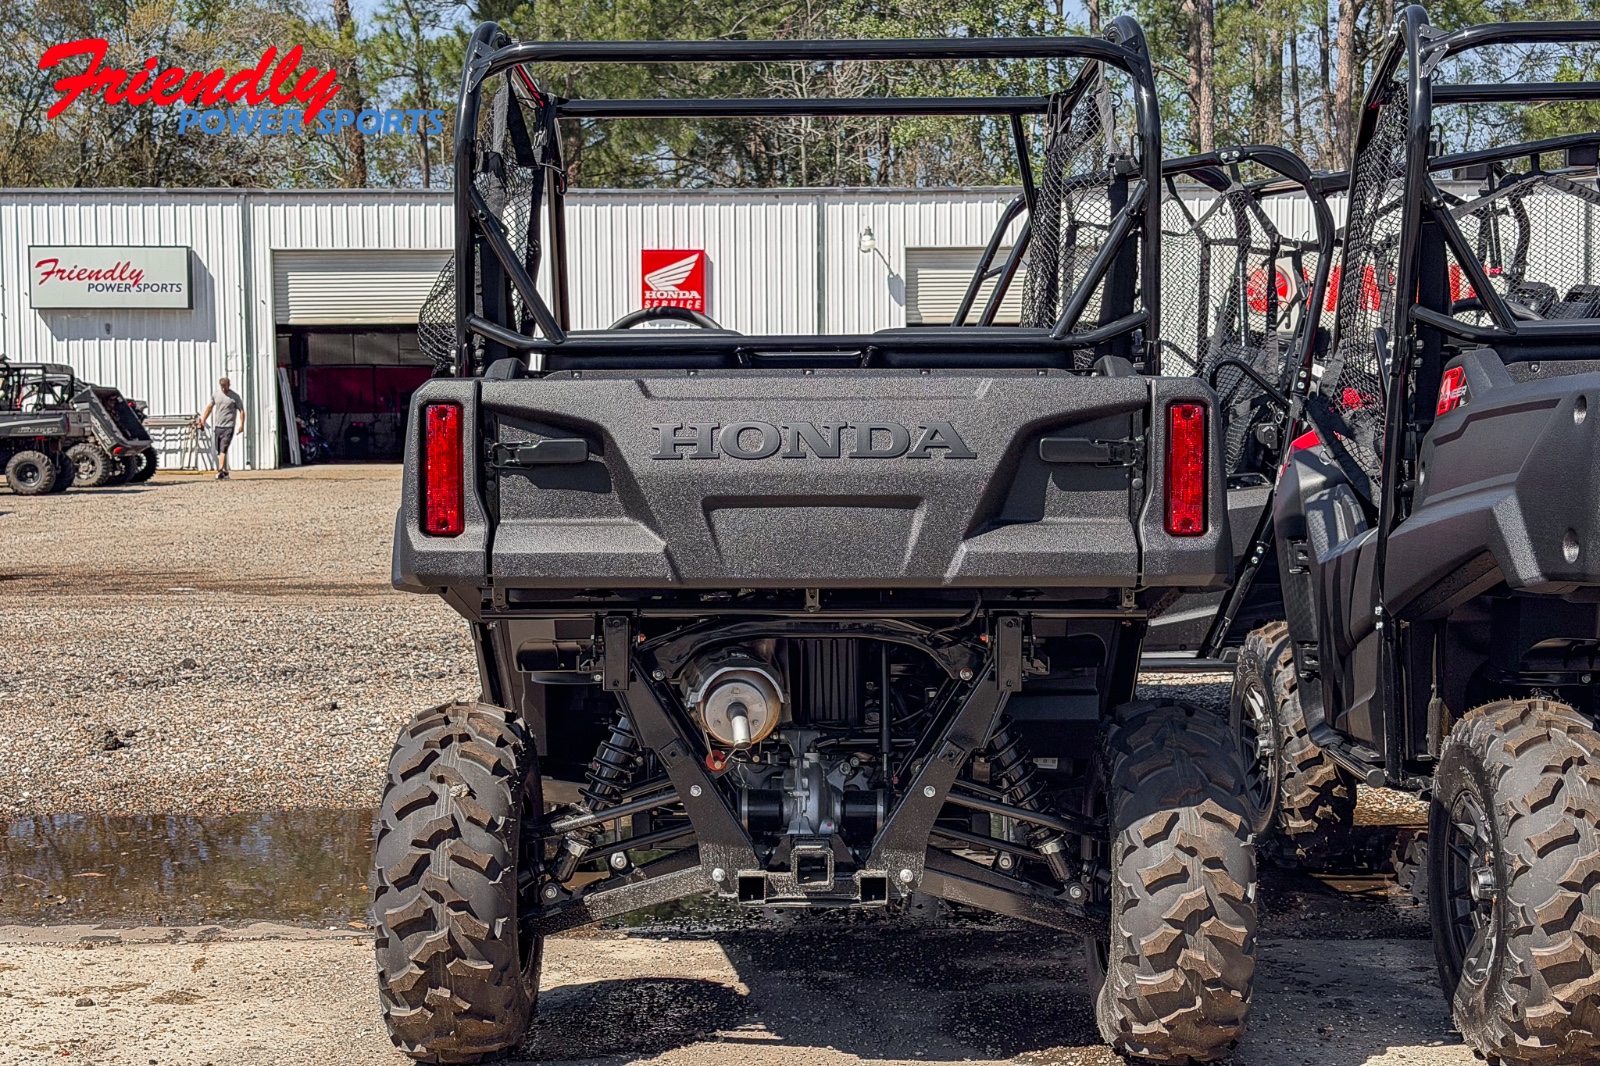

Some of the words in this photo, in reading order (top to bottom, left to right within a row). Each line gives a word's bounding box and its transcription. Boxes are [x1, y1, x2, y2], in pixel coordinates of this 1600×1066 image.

[35, 258, 144, 286] Friendly
[87, 282, 132, 293] POWER
[136, 282, 183, 293] SPORTS
[644, 290, 702, 299] HONDA
[644, 300, 702, 309] SERVICE
[651, 420, 978, 460] HONDA
